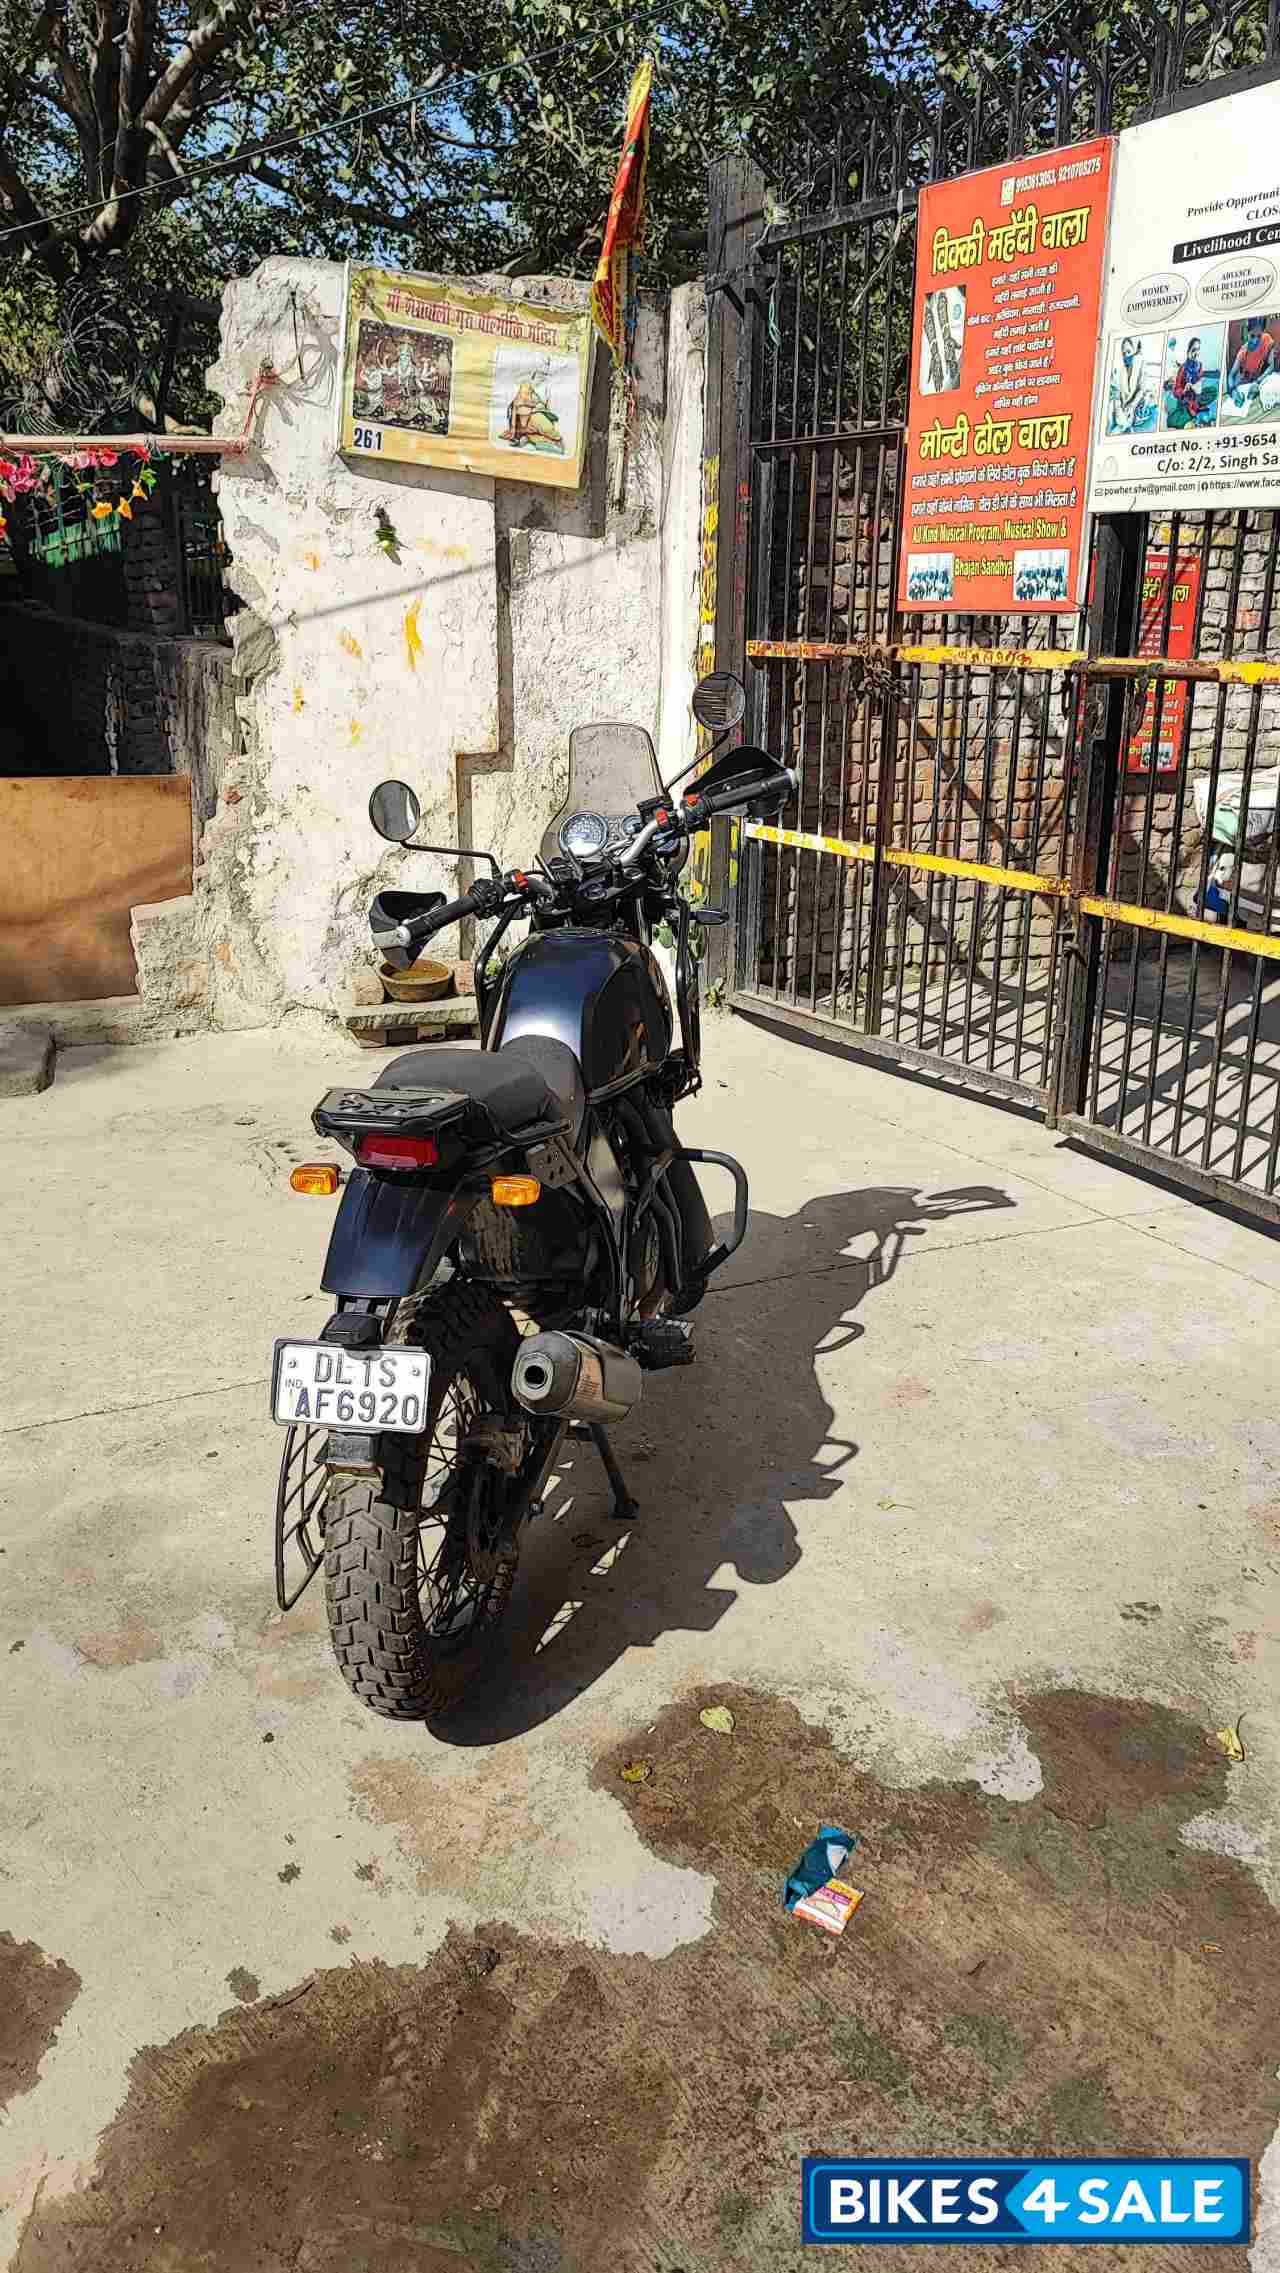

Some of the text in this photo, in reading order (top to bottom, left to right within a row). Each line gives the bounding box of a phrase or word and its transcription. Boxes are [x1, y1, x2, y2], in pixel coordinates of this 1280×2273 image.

[1187, 199, 1224, 217] Provide
[1247, 206, 1280, 221] CLOS
[932, 217, 985, 275] विक्की
[1041, 207, 1091, 249] वाला
[1182, 231, 1252, 258] Livelihood
[1202, 275, 1271, 295] SKILL DEVELOPMENT
[1222, 268, 1252, 281] ADVANCE
[1142, 284, 1170, 297] WOMEN
[1221, 289, 1247, 302] CENTRE
[1127, 293, 1183, 313] EMPOWERMENT
[353, 427, 381, 450] 261
[919, 410, 1072, 460] मोन्टी ढोल वाला
[1131, 441, 1177, 456] Contact
[1181, 439, 1202, 452] No.
[1214, 432, 1277, 449] +91-9654
[1157, 457, 1184, 474] C/o:
[1188, 455, 1215, 472] 2/2,
[1219, 452, 1258, 470] Singh
[939, 523, 967, 543] Musical
[1002, 518, 1035, 541] Musical
[1036, 518, 1057, 538] Show
[954, 555, 1014, 580] Bhajan Sandhya
[295, 1387, 420, 1425] AF6920
